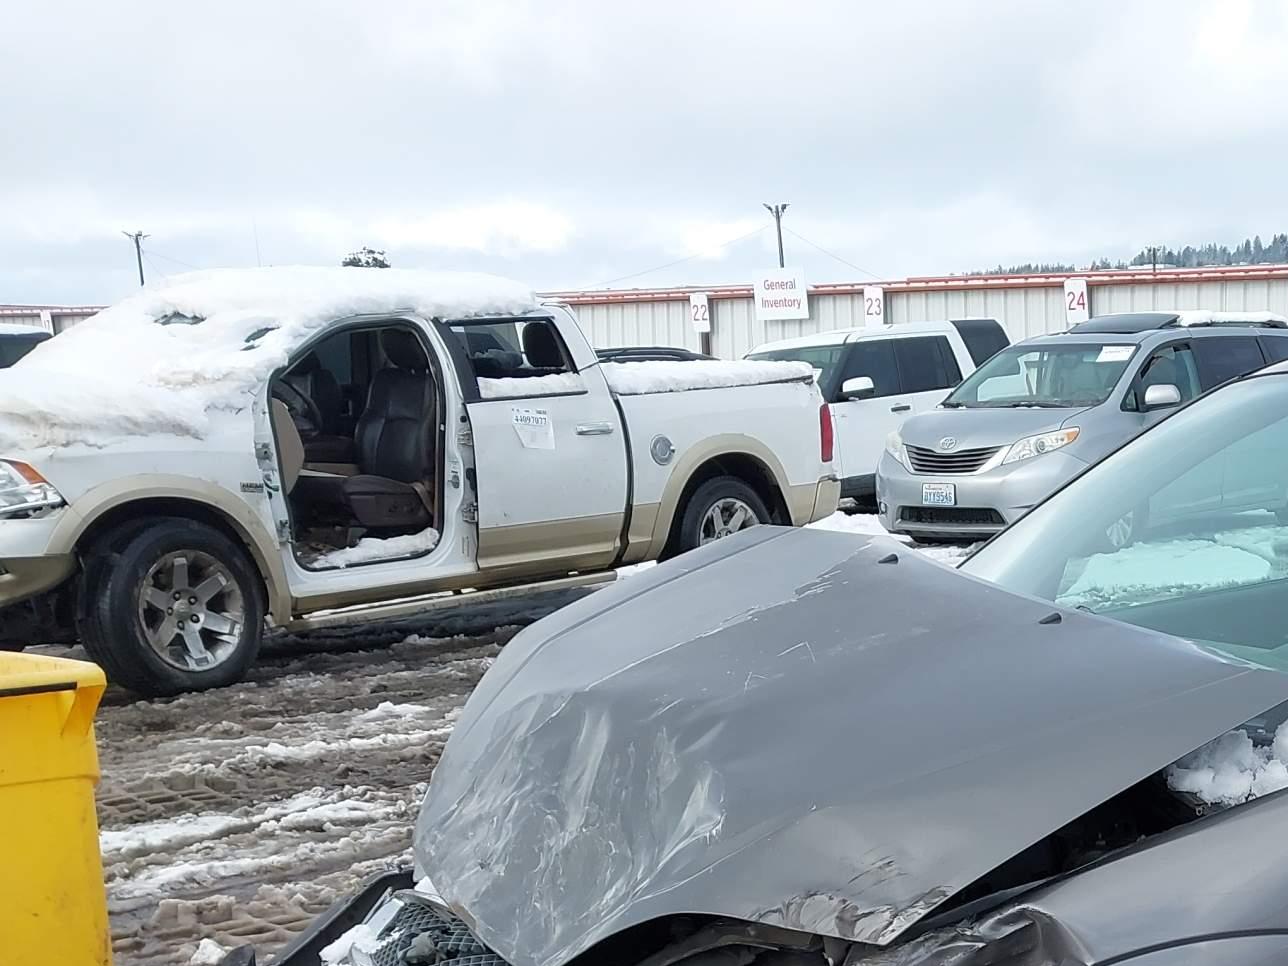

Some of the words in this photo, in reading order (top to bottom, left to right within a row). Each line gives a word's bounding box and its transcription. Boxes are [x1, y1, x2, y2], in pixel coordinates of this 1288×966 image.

[763, 279, 796, 290] General
[761, 297, 801, 309] Inventory
[866, 298, 882, 316] 23
[1067, 291, 1086, 311] 24
[692, 304, 708, 322] 22
